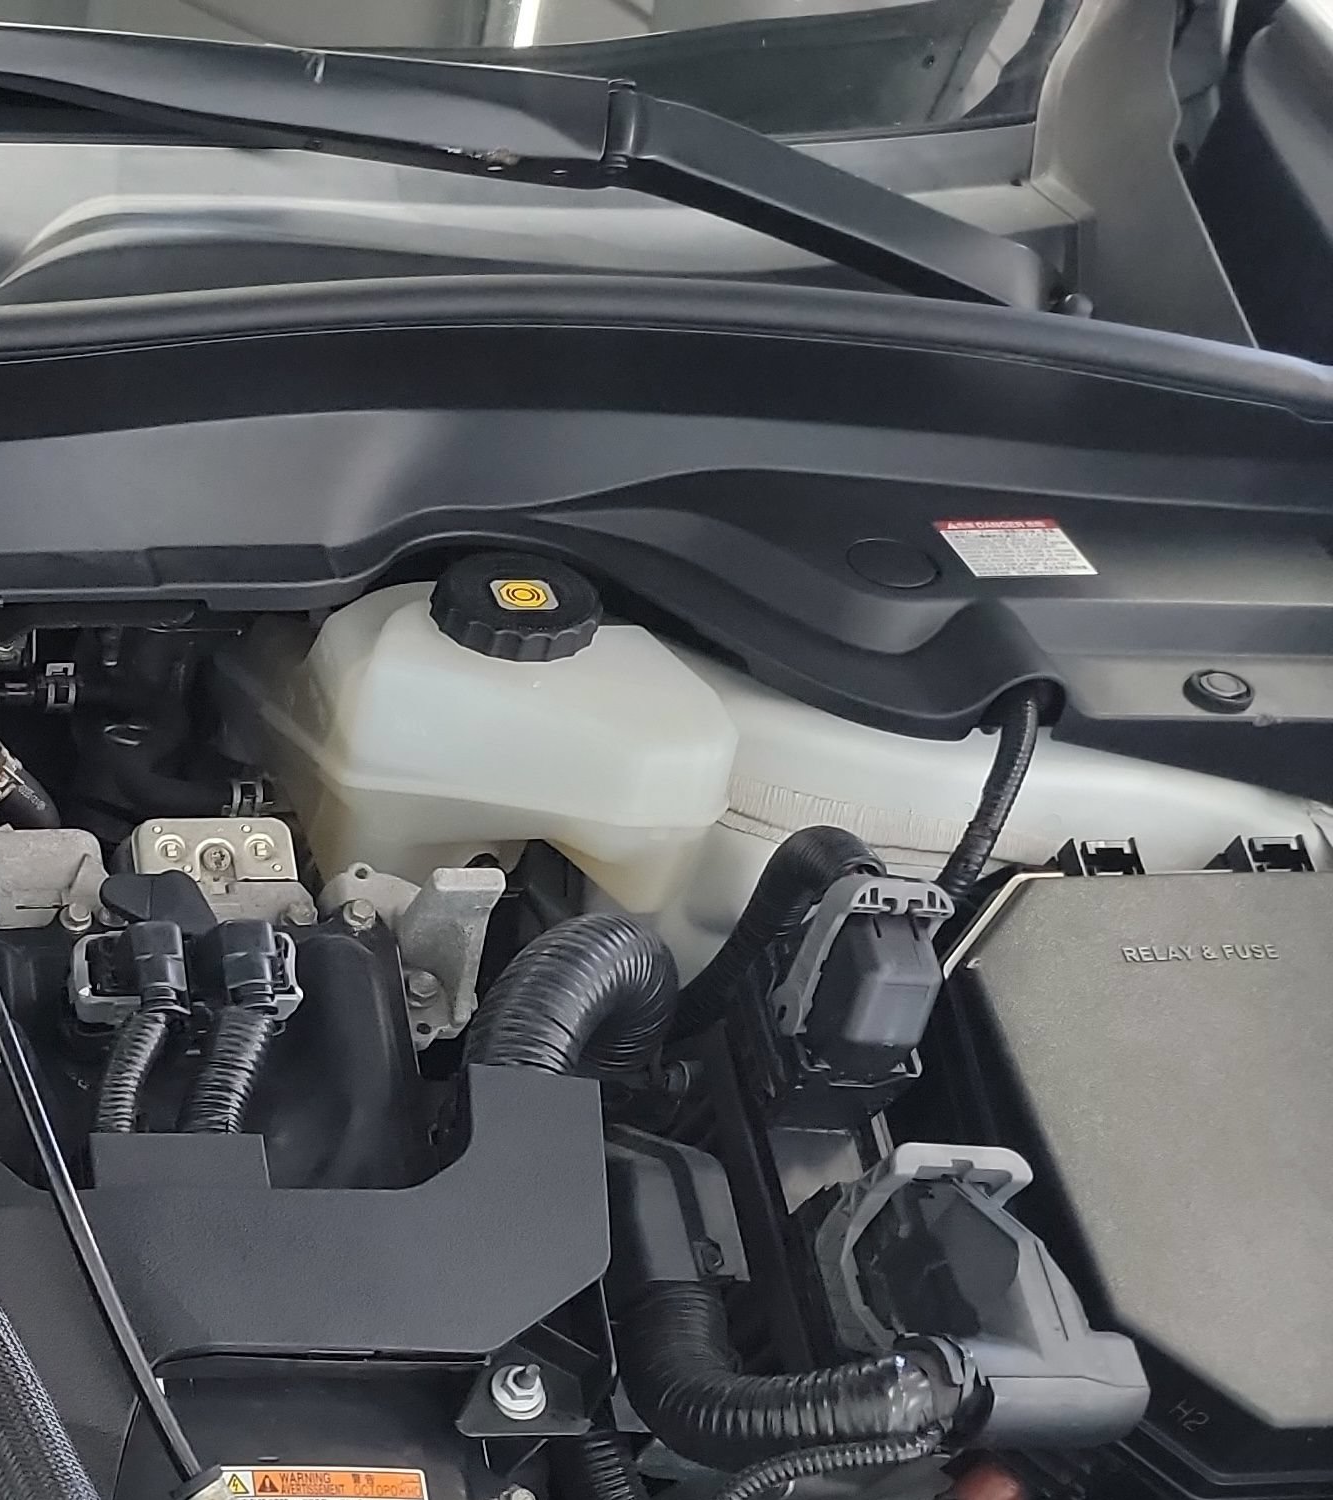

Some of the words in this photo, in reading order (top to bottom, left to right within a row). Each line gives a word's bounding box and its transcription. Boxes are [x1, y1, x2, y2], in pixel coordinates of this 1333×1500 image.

[975, 521, 1025, 529] DANGER
[1121, 946, 1193, 963] RELAY
[1201, 944, 1220, 961] &
[1221, 944, 1281, 960] FUSE
[1168, 1398, 1210, 1432] H2
[279, 1472, 332, 1484] WARNING
[281, 1484, 345, 1495] AVERTISSEMENT
